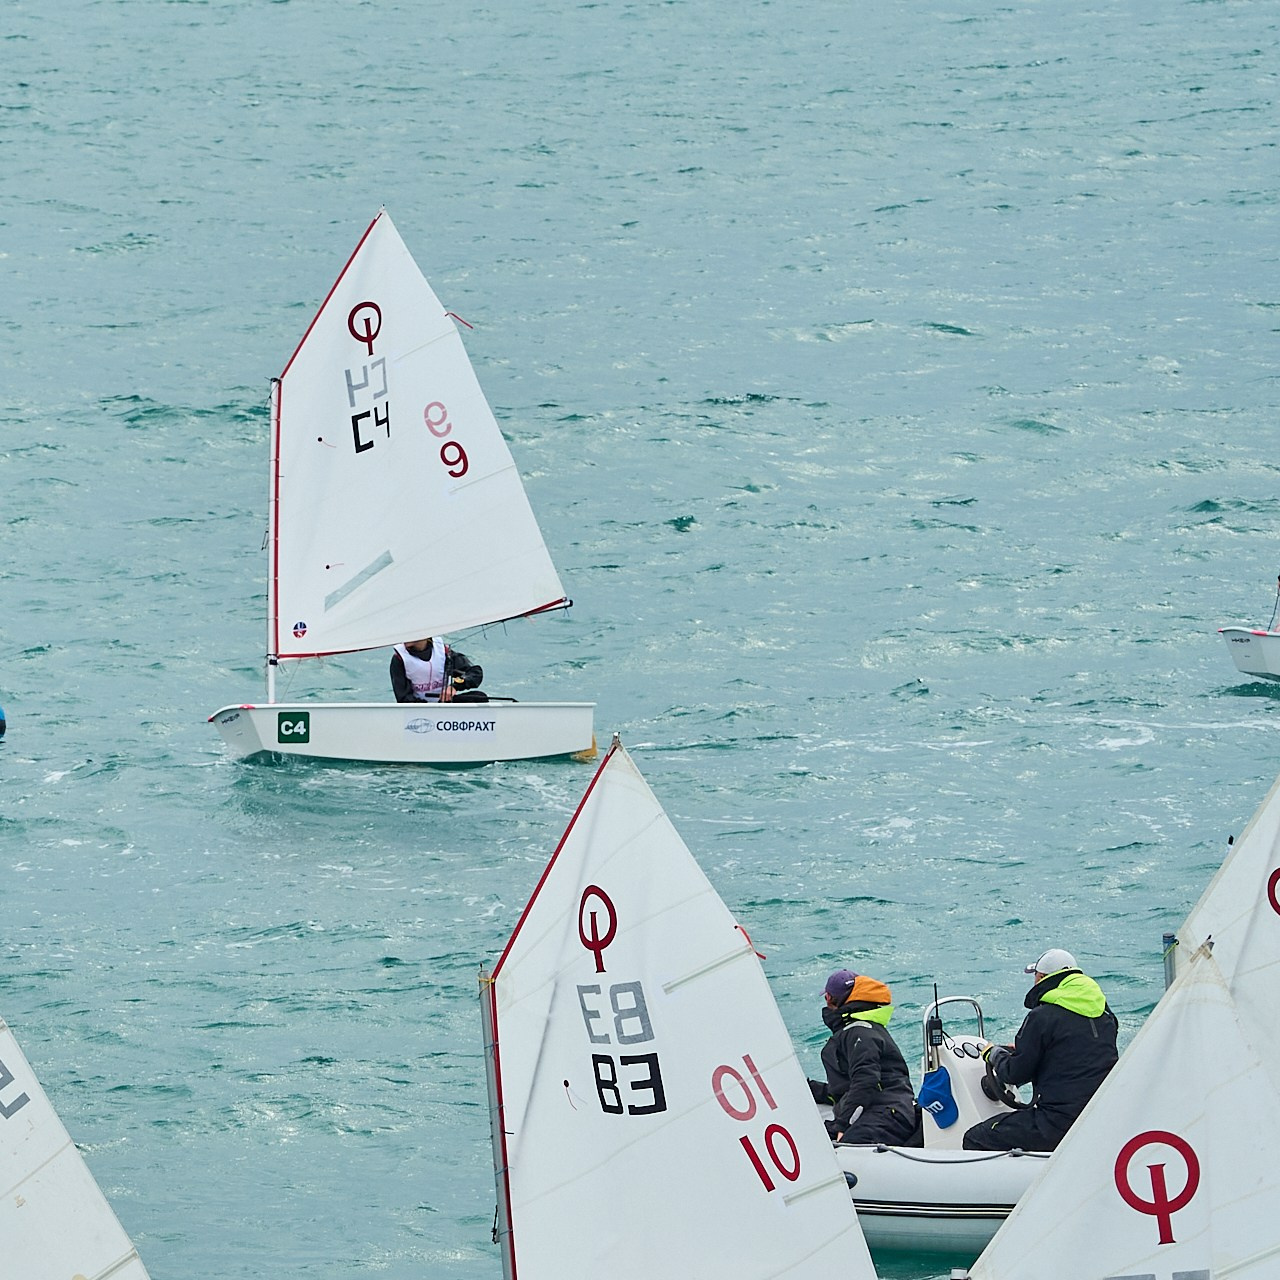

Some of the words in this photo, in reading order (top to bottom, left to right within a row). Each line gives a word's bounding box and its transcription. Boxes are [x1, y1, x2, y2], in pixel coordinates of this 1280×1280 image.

[351, 401, 390, 453] C4
[440, 441, 468, 478] 9
[281, 721, 306, 735] C4
[436, 721, 496, 731] СОВФРАХТ
[592, 1053, 667, 1115] B3
[739, 1123, 801, 1192] 10
